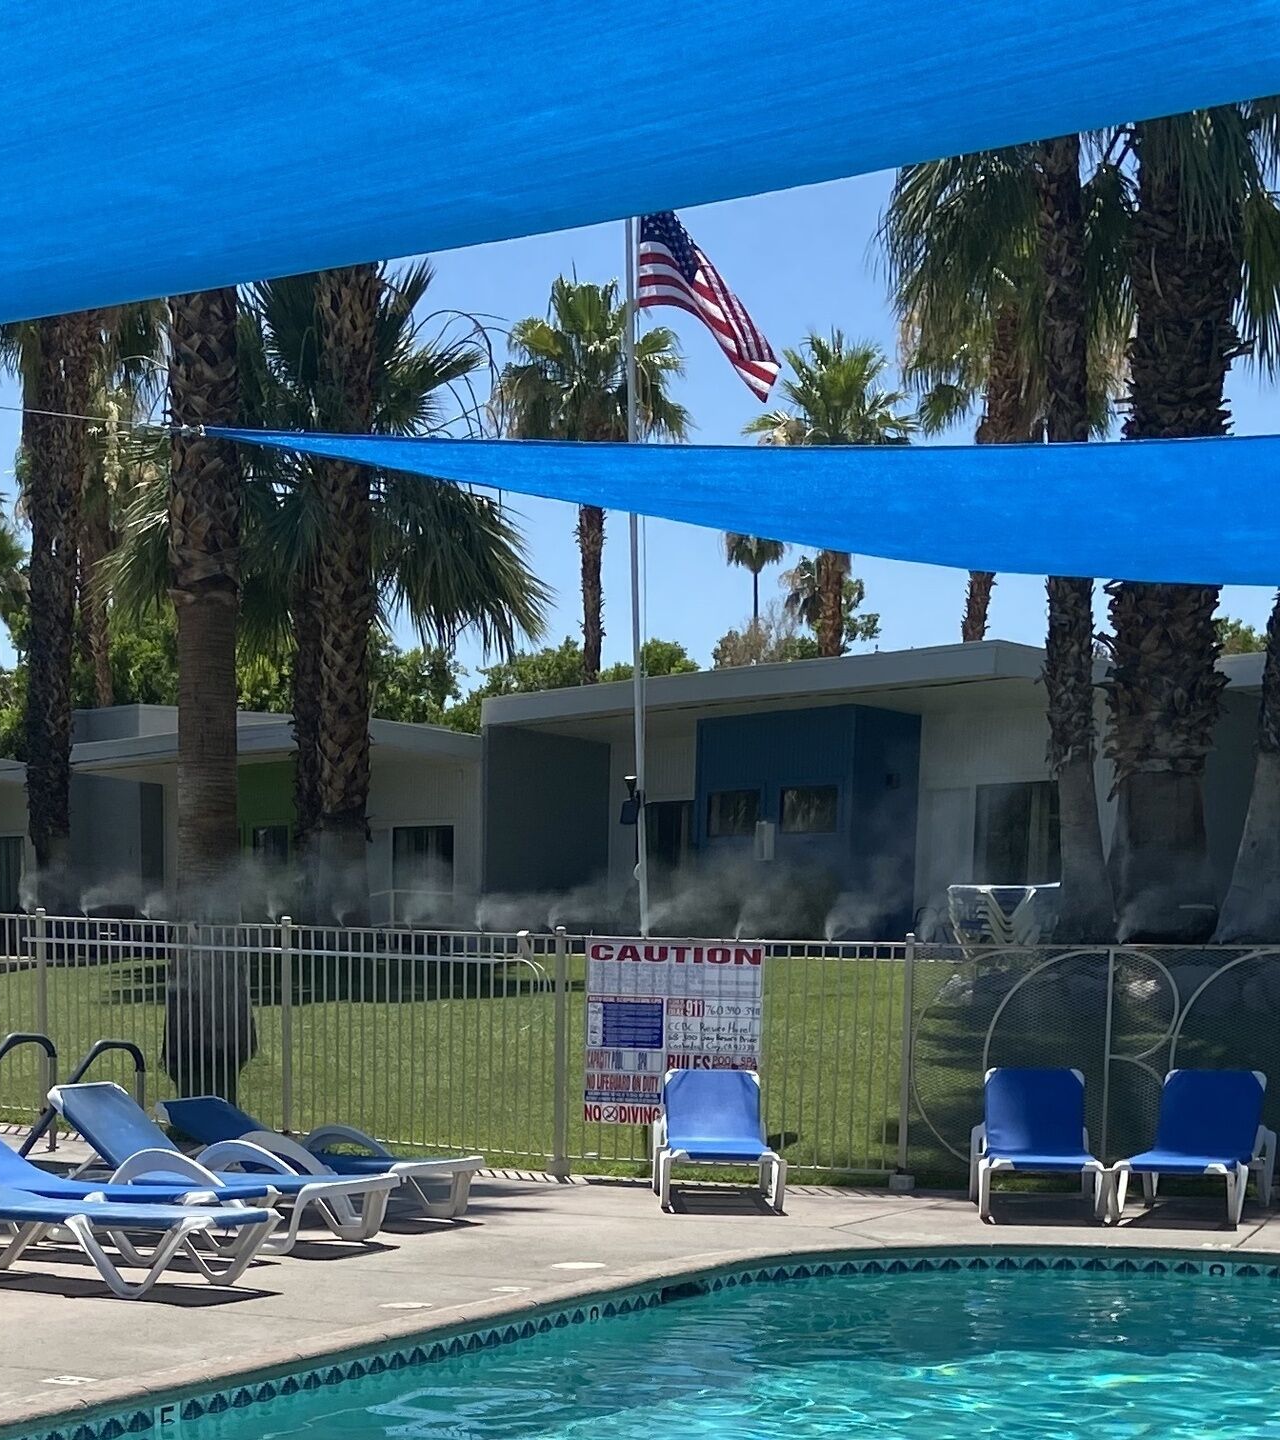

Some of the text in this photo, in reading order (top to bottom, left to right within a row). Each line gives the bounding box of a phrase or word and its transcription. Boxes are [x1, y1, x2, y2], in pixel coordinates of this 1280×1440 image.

[591, 945, 761, 965] CAUTION
[686, 1000, 703, 1018] 911
[705, 1005, 724, 1016] 760
[586, 1073, 659, 1092] NO LIFEGUARD ON DUTY
[584, 1104, 661, 1124] NO DIVING
